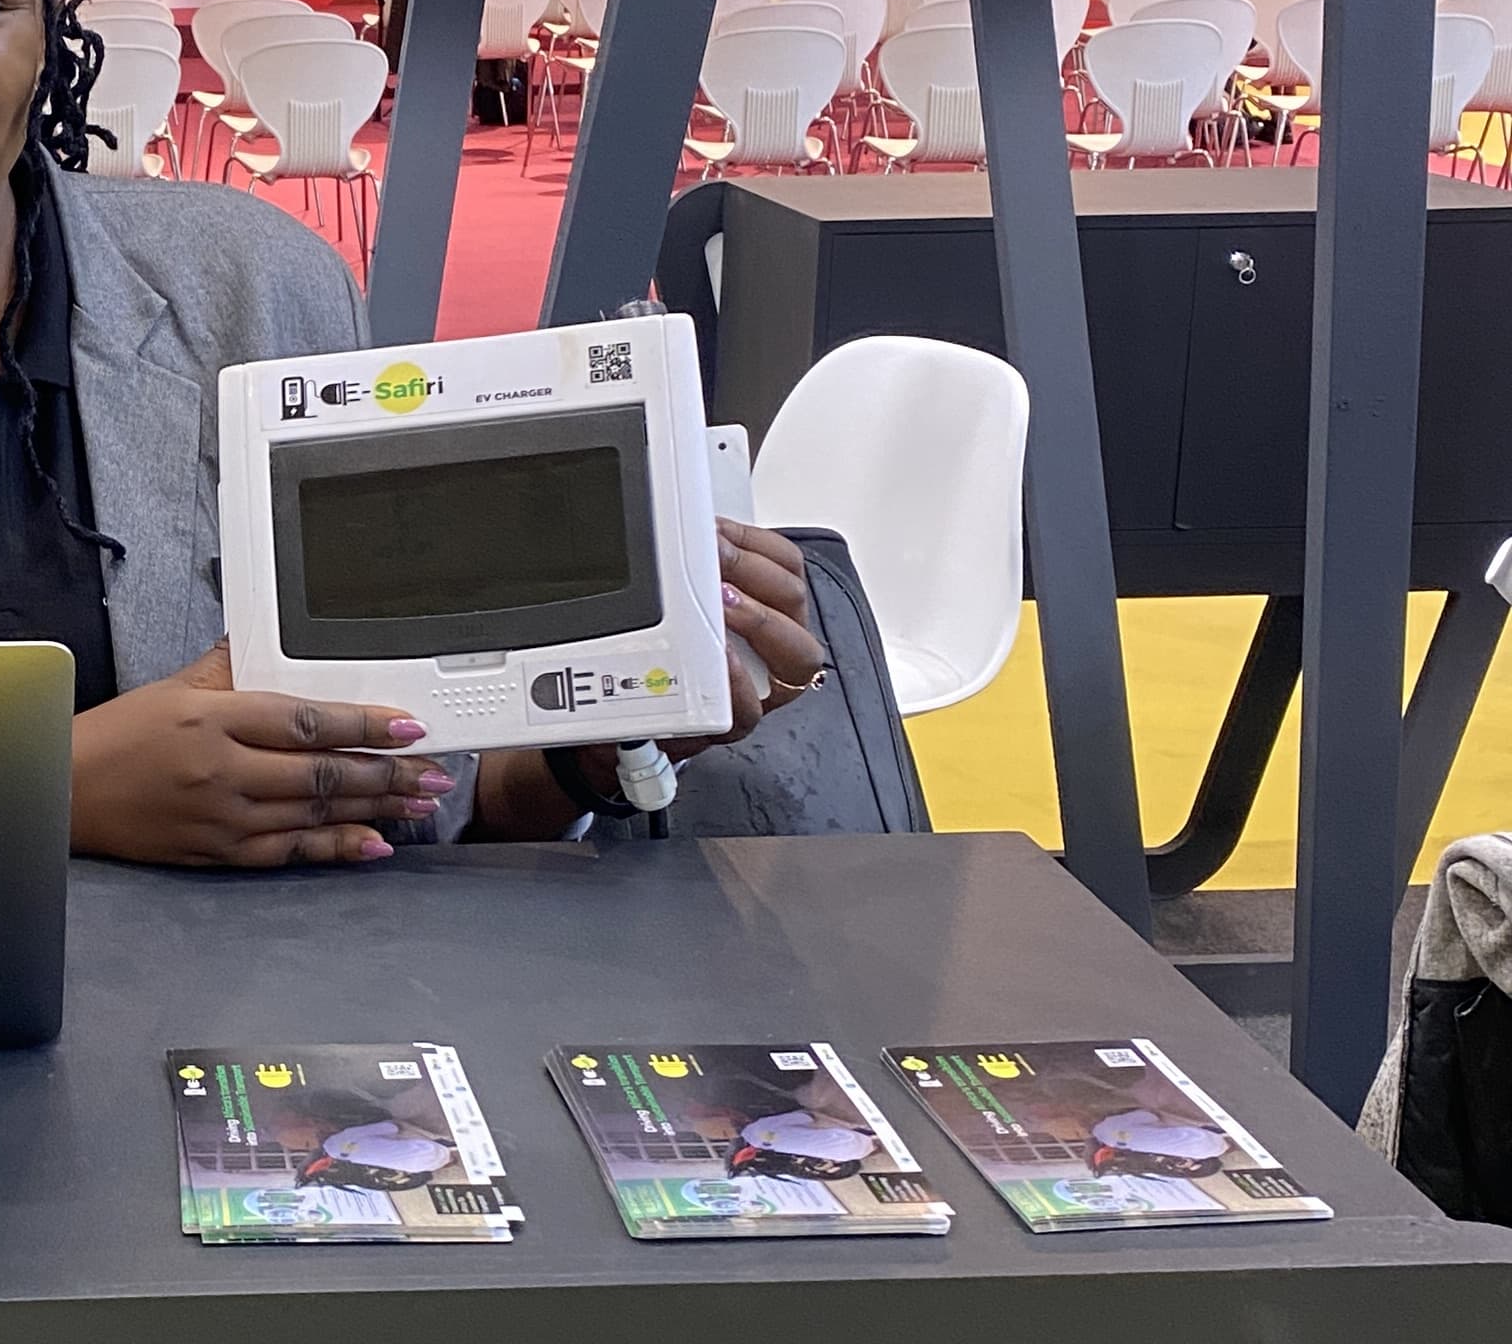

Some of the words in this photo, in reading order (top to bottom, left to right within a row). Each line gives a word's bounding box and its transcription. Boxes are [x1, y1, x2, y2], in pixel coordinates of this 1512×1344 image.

[476, 393, 491, 404] EV
[494, 387, 553, 402] CHARGER
[226, 1119, 242, 1143] Driving
[636, 1109, 658, 1133] Driving
